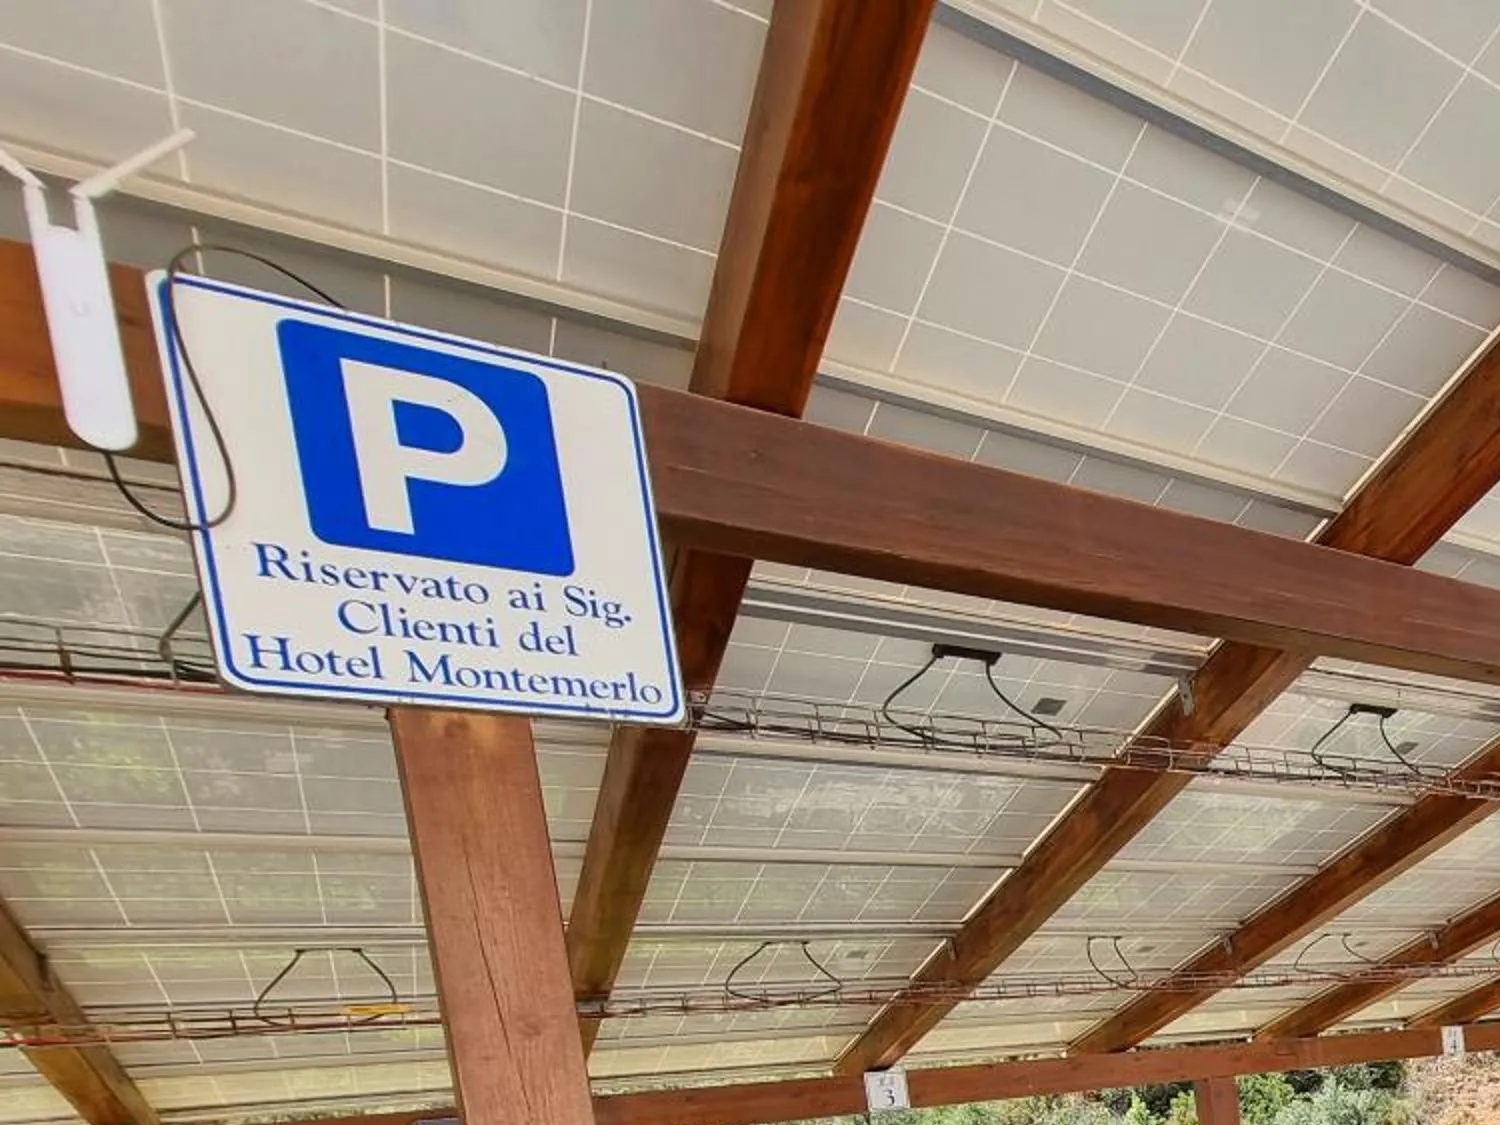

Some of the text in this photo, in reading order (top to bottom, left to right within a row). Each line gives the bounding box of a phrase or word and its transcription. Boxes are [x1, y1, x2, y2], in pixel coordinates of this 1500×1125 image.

[340, 357, 508, 535] P
[254, 542, 632, 628] Riservato ai Sig.
[338, 598, 579, 657] Clienti del
[245, 634, 662, 706] Hotel Montemerlo
